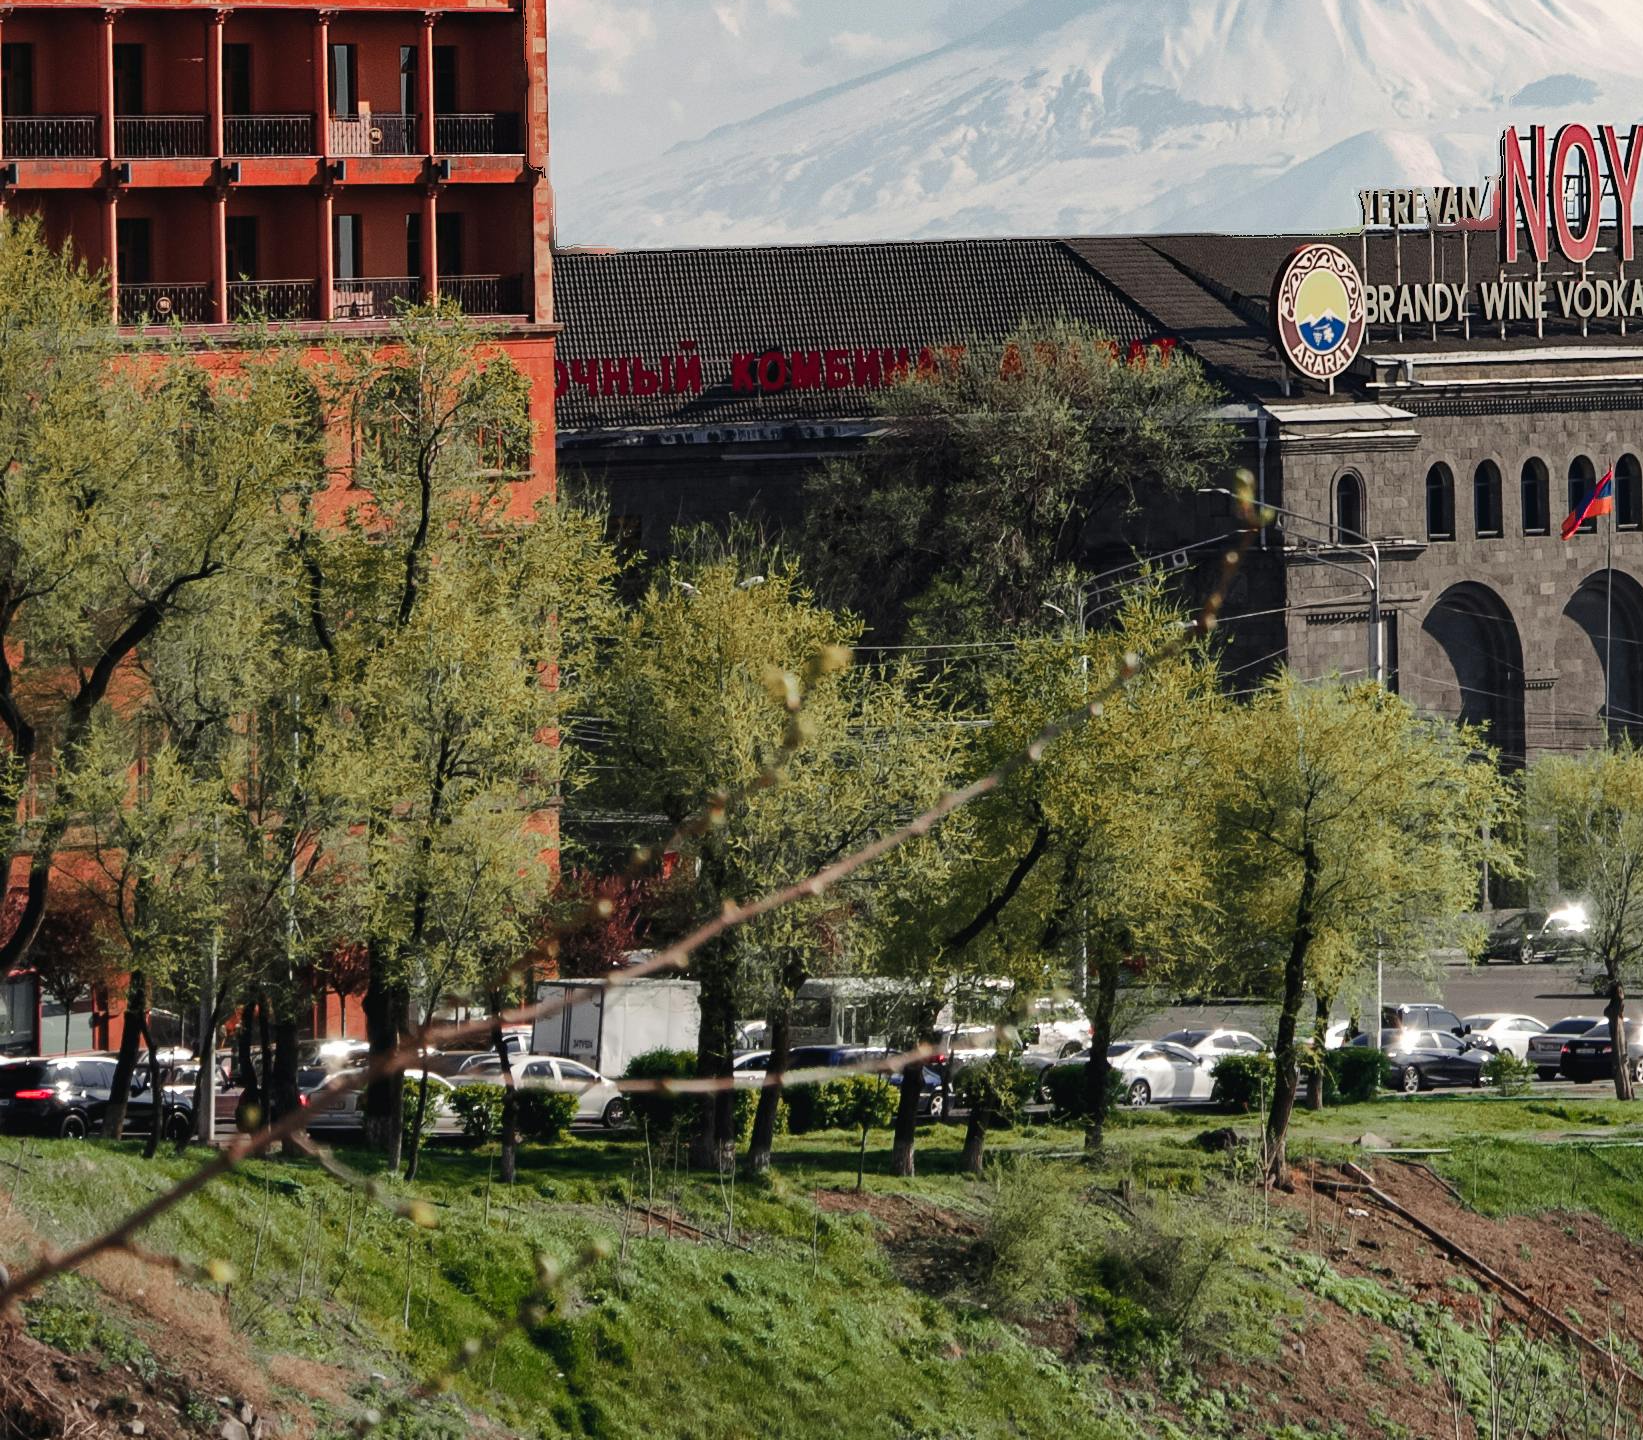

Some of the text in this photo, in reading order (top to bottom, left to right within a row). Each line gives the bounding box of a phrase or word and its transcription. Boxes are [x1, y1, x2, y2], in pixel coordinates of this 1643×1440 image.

[1360, 186, 1480, 224] YEREVAN
[1365, 282, 1467, 324] BRANDY
[1480, 279, 1548, 321] WINE
[1291, 337, 1354, 375] ARARAT
